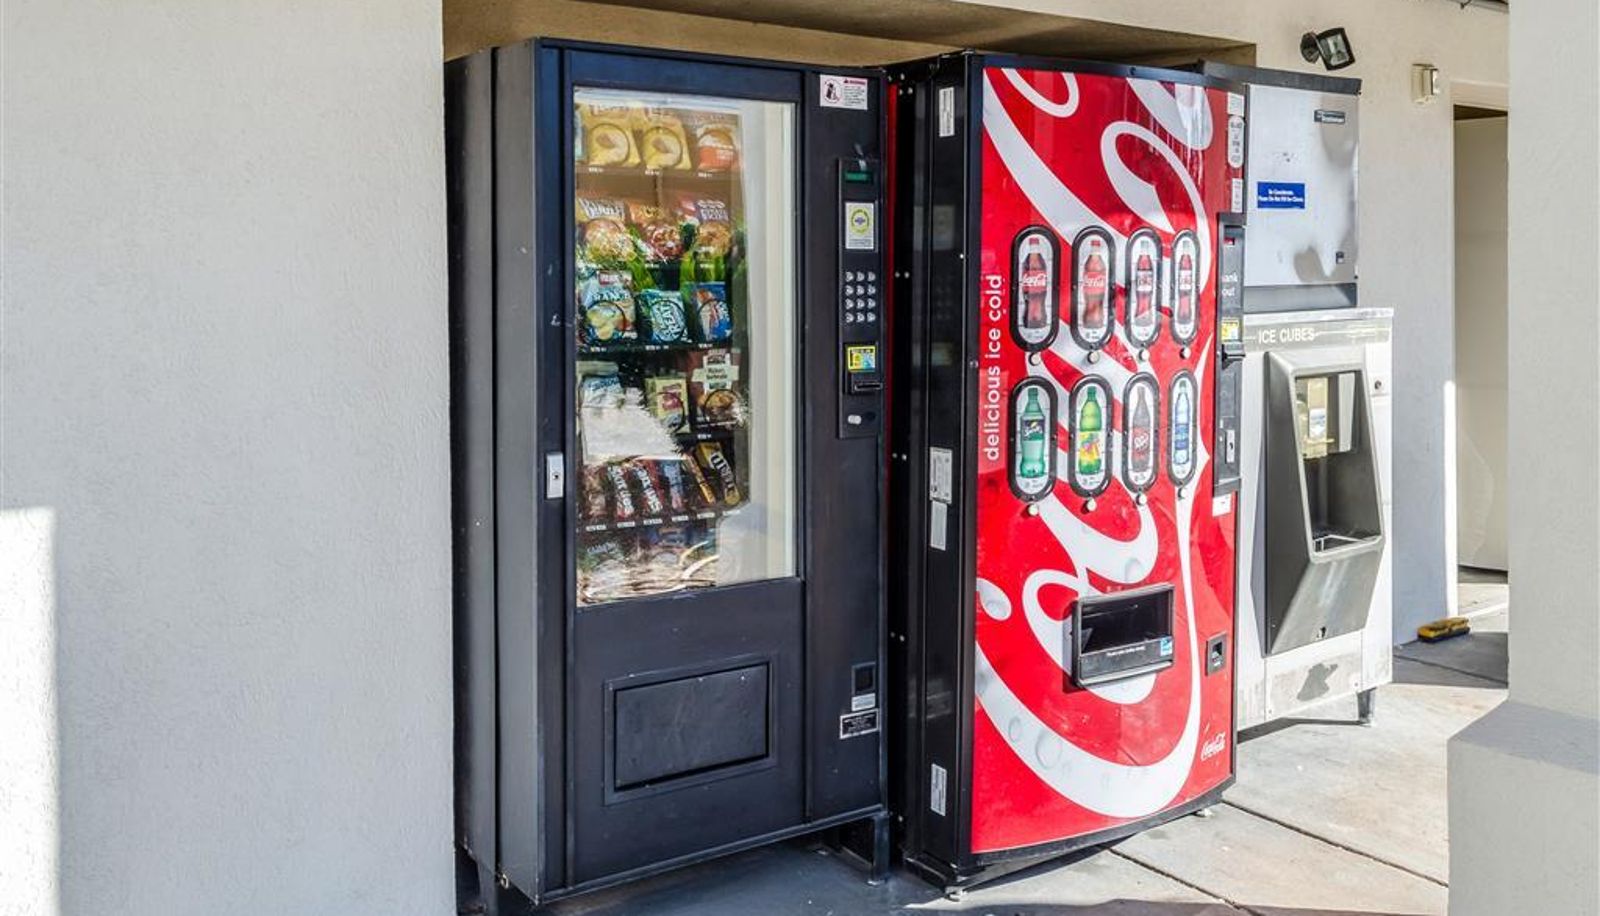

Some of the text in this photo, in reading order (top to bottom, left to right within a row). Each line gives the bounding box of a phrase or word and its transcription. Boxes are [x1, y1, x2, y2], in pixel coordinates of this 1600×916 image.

[984, 274, 1001, 461] delicious ice cold
[1258, 327, 1315, 344] ICE CUBES
